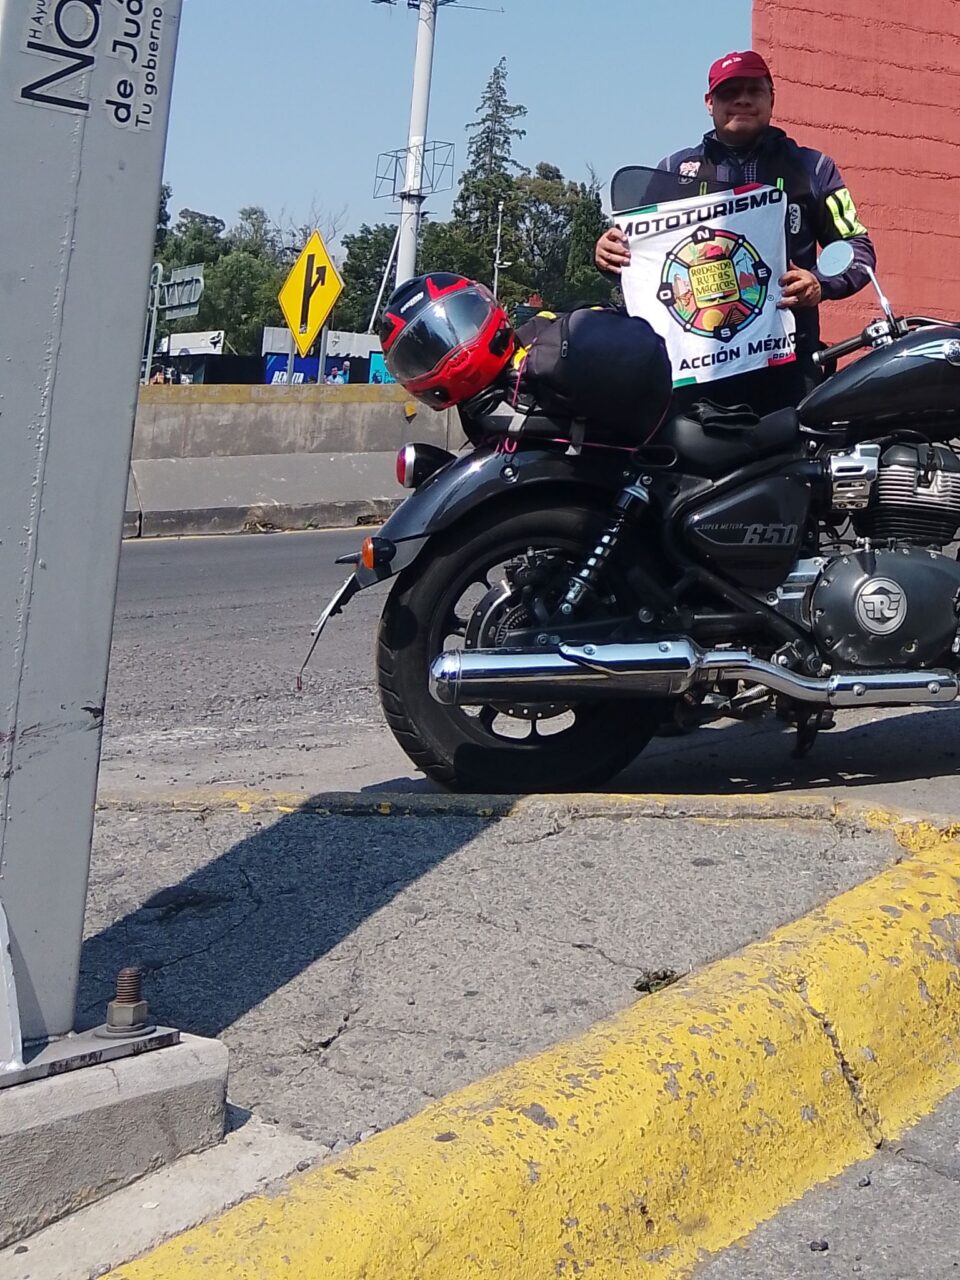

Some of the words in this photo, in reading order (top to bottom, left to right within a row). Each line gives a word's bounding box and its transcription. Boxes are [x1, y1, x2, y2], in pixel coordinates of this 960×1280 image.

[141, 6, 163, 96] gobierno
[105, 79, 134, 123] de
[135, 103, 152, 127] Tu
[615, 189, 783, 237] MOTOTURISMO
[697, 229, 710, 240] N
[720, 328, 732, 338] S
[679, 346, 740, 371] ACCIÓN
[743, 524, 798, 545] 650
